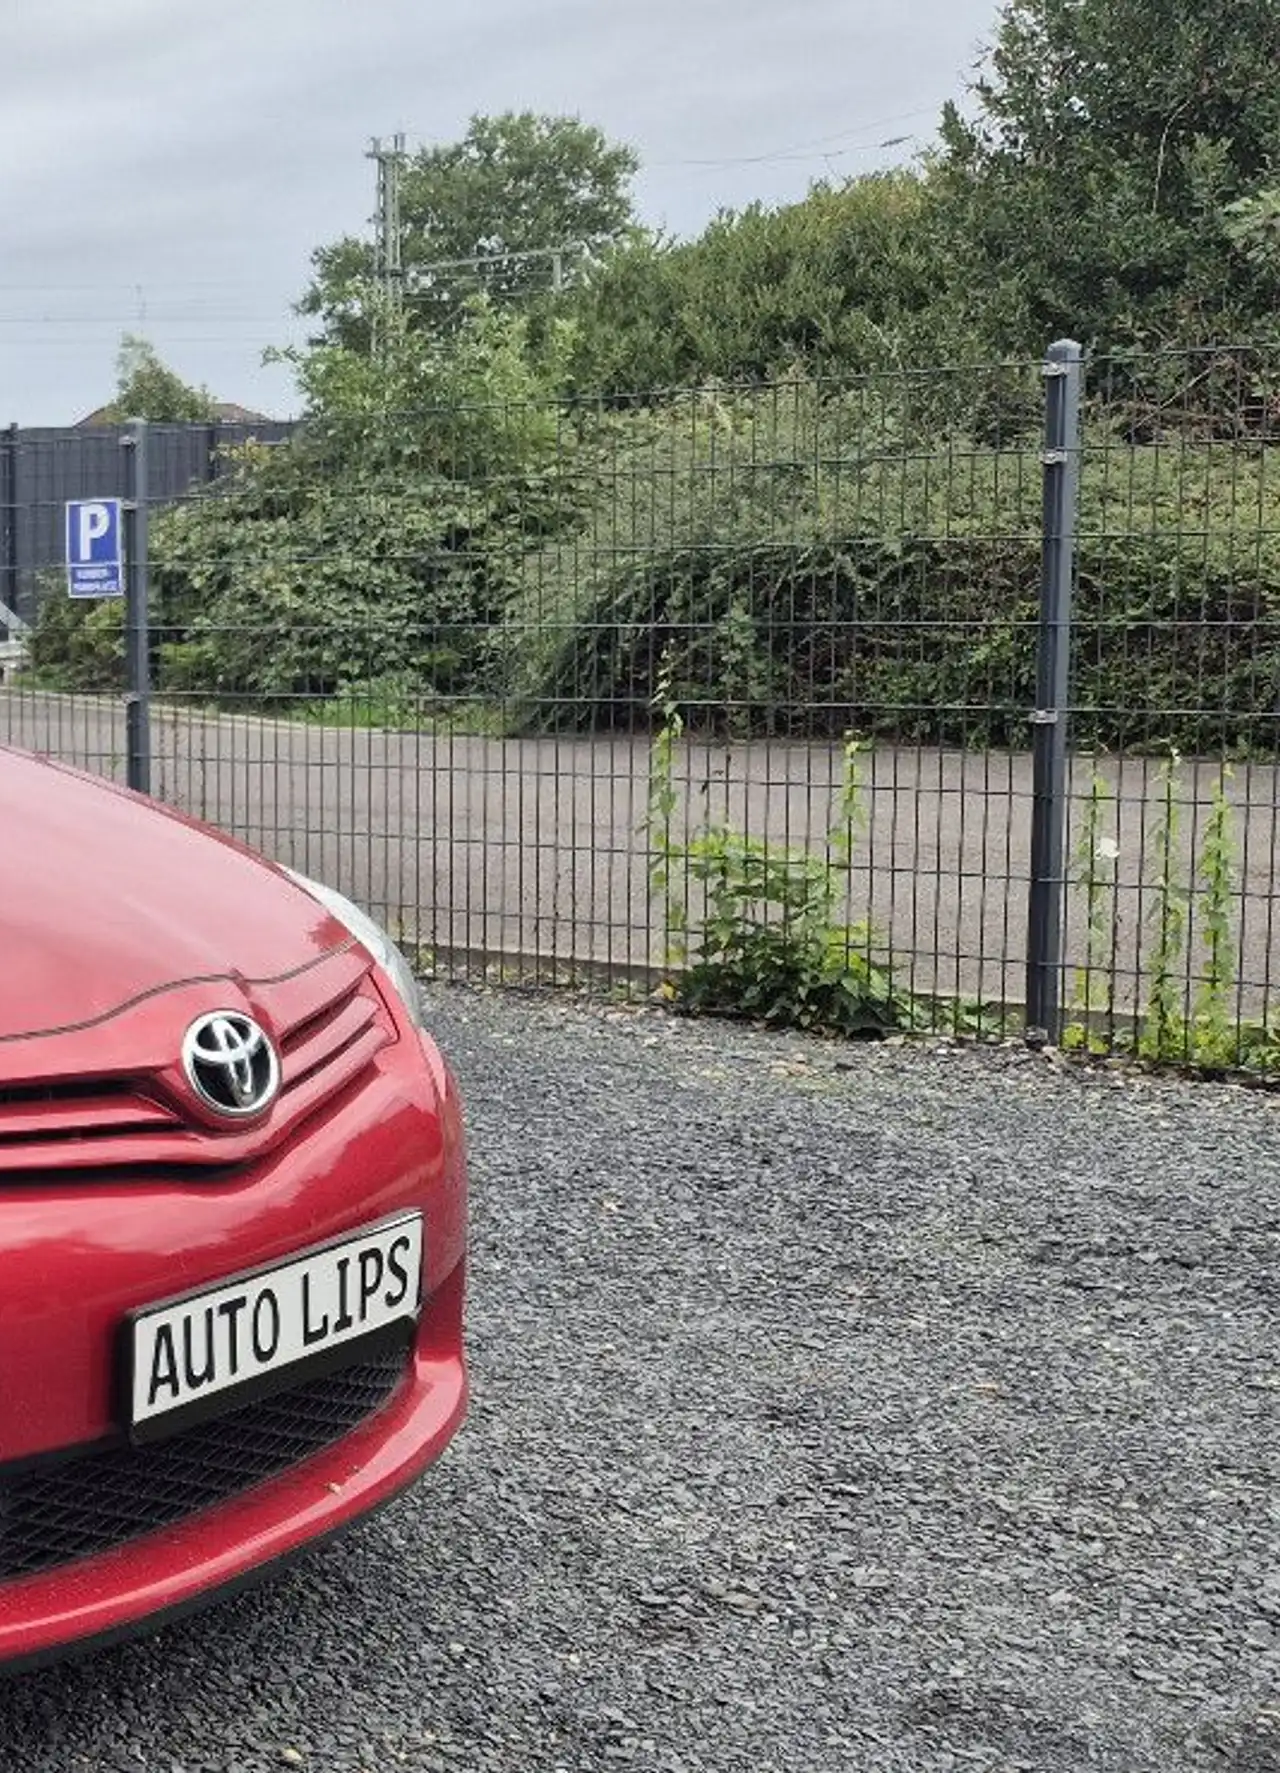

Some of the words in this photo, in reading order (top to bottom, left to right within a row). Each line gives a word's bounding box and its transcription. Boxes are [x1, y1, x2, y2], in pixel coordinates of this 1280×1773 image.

[79, 503, 110, 561] P
[146, 1287, 280, 1406] AUTO
[302, 1235, 411, 1347] LIPS
